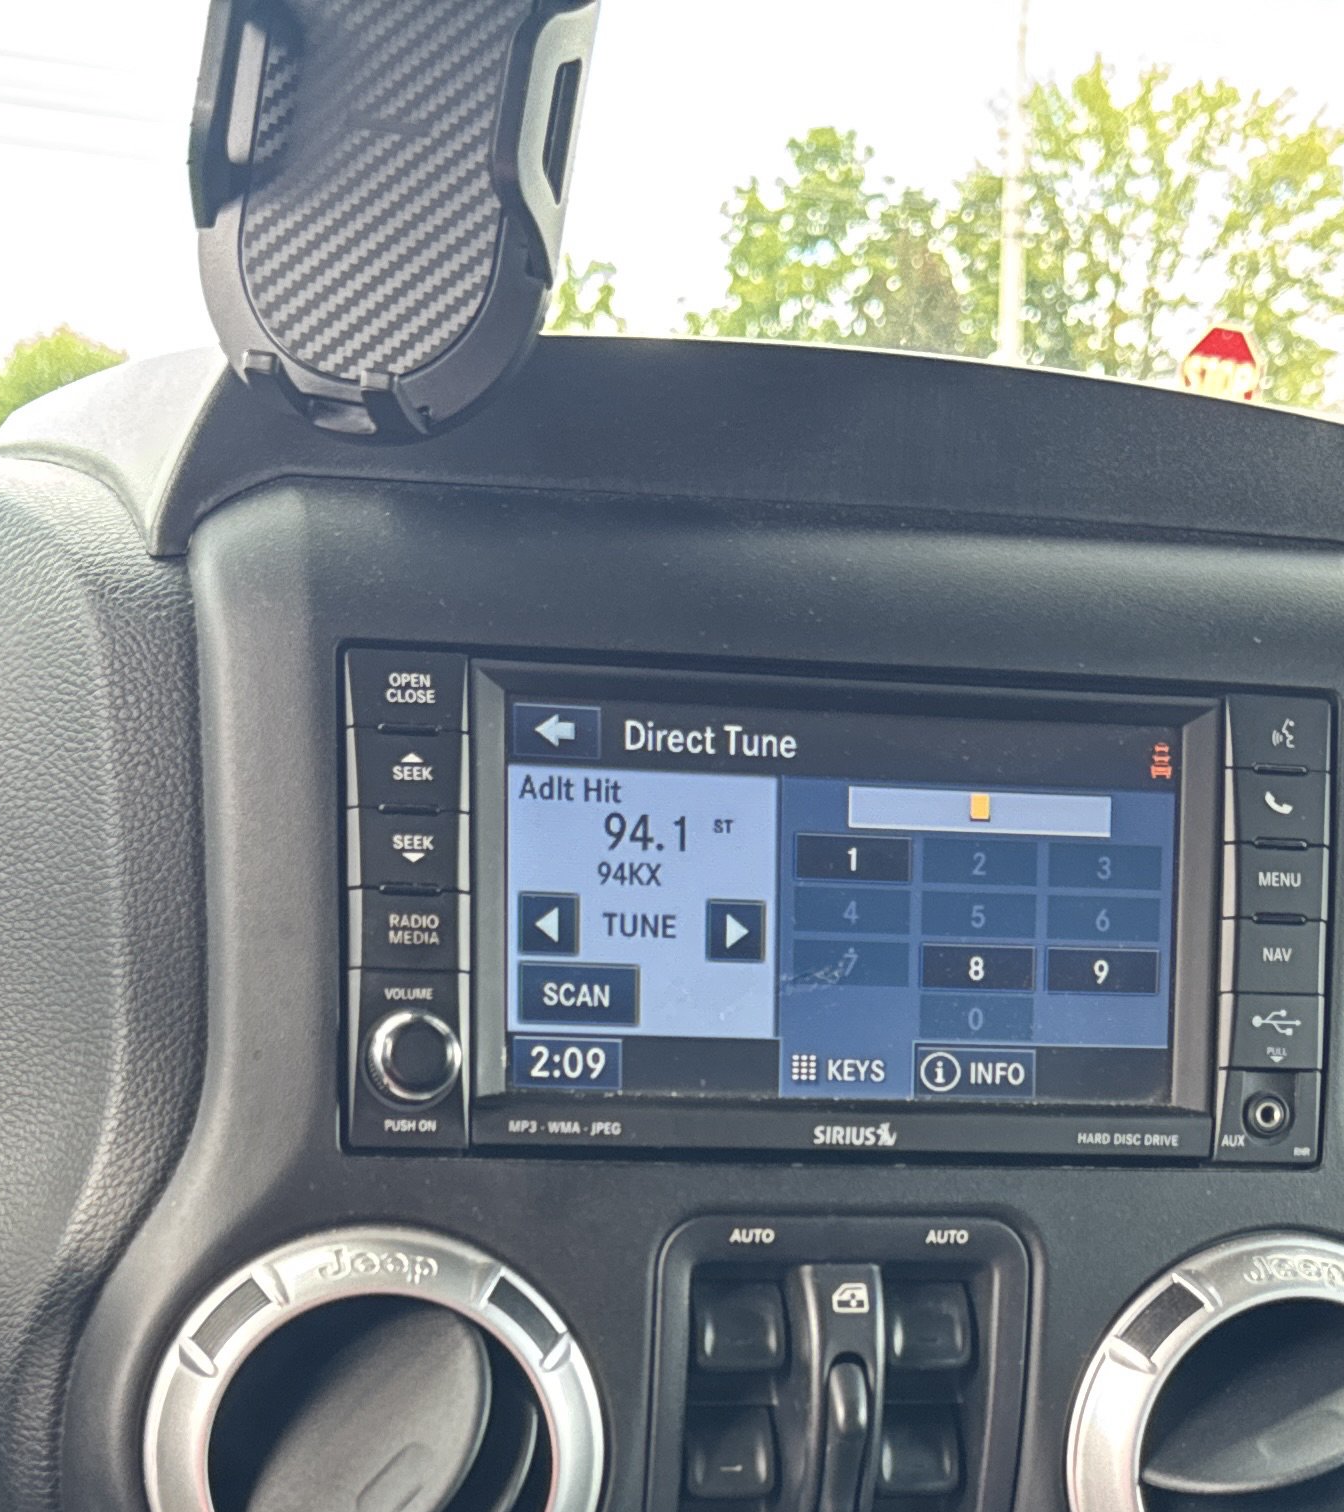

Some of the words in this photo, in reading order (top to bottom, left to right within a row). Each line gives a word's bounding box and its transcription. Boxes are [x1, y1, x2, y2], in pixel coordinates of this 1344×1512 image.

[389, 673, 431, 689] OPEN
[386, 688, 436, 705] CLOSE
[624, 720, 716, 756] Direct
[724, 726, 798, 759] Tune
[392, 766, 433, 782] SEEK
[583, 778, 622, 804] Hit
[603, 812, 688, 852] 94.1
[713, 819, 734, 835] ST
[392, 835, 434, 851] SEEK
[847, 848, 858, 871] 1
[972, 854, 987, 876] 2
[1097, 857, 1112, 880] 3
[597, 862, 662, 887] 94KX
[1258, 871, 1302, 889] MENU
[388, 914, 440, 930] RADIO
[843, 901, 859, 923] 4
[971, 906, 986, 928] 5
[1096, 909, 1111, 931] 6
[602, 912, 677, 938] TUNE
[388, 929, 440, 946] MEDIA
[1262, 948, 1293, 963] NAV
[969, 957, 984, 981] 8
[1093, 960, 1109, 984] 9
[384, 987, 434, 1001] VOLUME
[542, 983, 611, 1007] SCAN
[969, 1008, 984, 1031] 0
[1266, 1046, 1288, 1057] PULL
[530, 1048, 606, 1078] 2:09
[827, 1060, 886, 1082] KEYS
[969, 1062, 1026, 1084] INFO
[384, 1119, 417, 1133] PUSH
[418, 1119, 437, 1133] ON
[508, 1120, 538, 1135] MP3
[548, 1121, 581, 1135] WMA
[590, 1121, 622, 1136] JPEG
[813, 1125, 877, 1146] SIRIUS
[1077, 1133, 1111, 1146] HARD
[1113, 1133, 1143, 1147] DISC
[1144, 1133, 1179, 1148] DRIVE
[1220, 1134, 1246, 1148] AUX
[730, 1228, 775, 1245] AUTO
[924, 1229, 970, 1246] AUTO
[318, 1246, 439, 1285] Jeep
